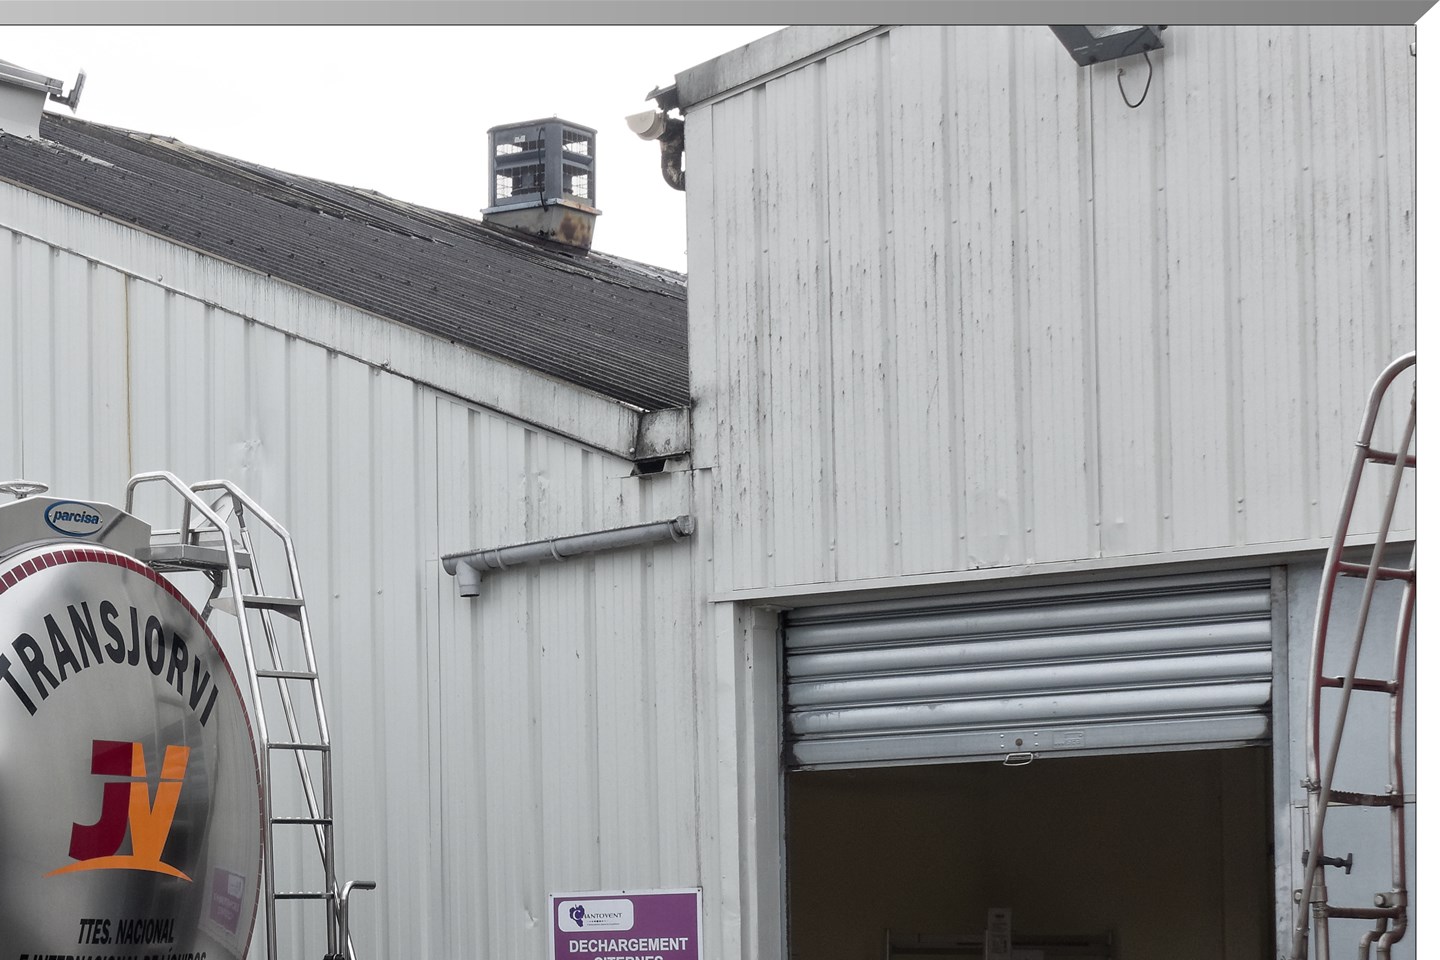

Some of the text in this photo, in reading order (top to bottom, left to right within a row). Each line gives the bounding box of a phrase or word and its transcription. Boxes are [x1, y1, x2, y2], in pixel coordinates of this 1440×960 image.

[53, 509, 99, 525] parcisa
[77, 918, 175, 945] TTES. NACIONAL
[569, 937, 689, 953] DECHARGEMENT
